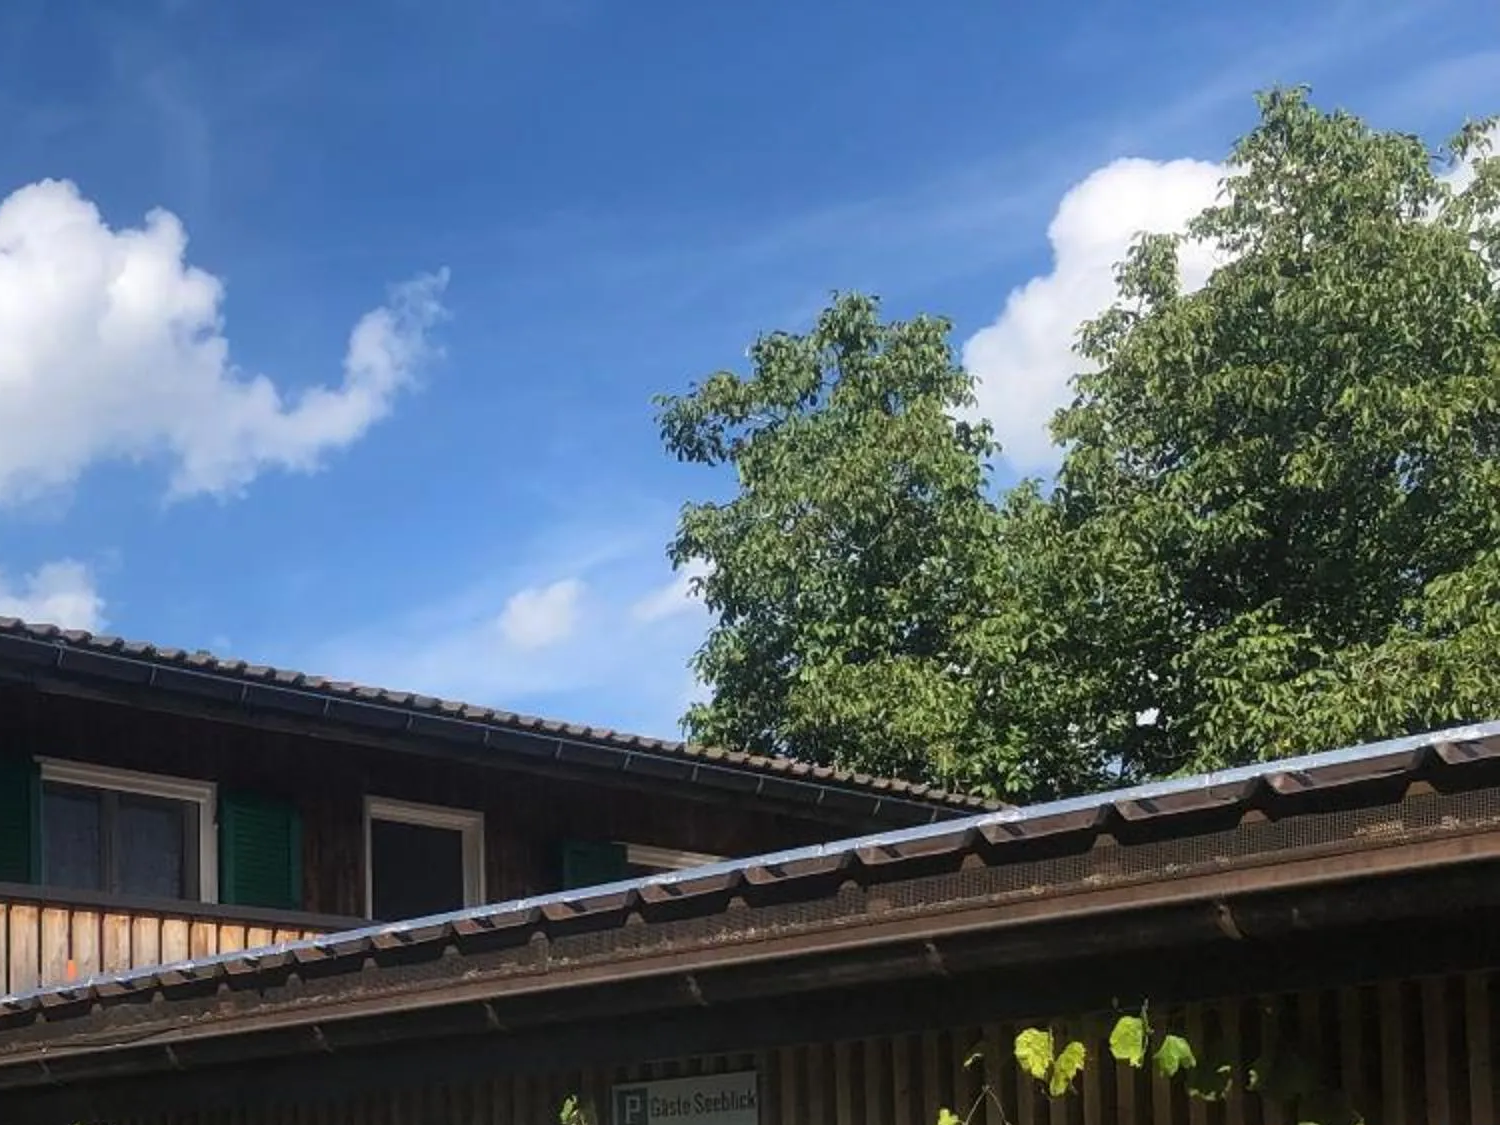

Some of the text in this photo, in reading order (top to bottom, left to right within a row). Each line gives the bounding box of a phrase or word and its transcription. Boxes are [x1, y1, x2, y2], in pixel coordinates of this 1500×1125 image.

[625, 1089, 757, 1125] P Gäste Seeblick
